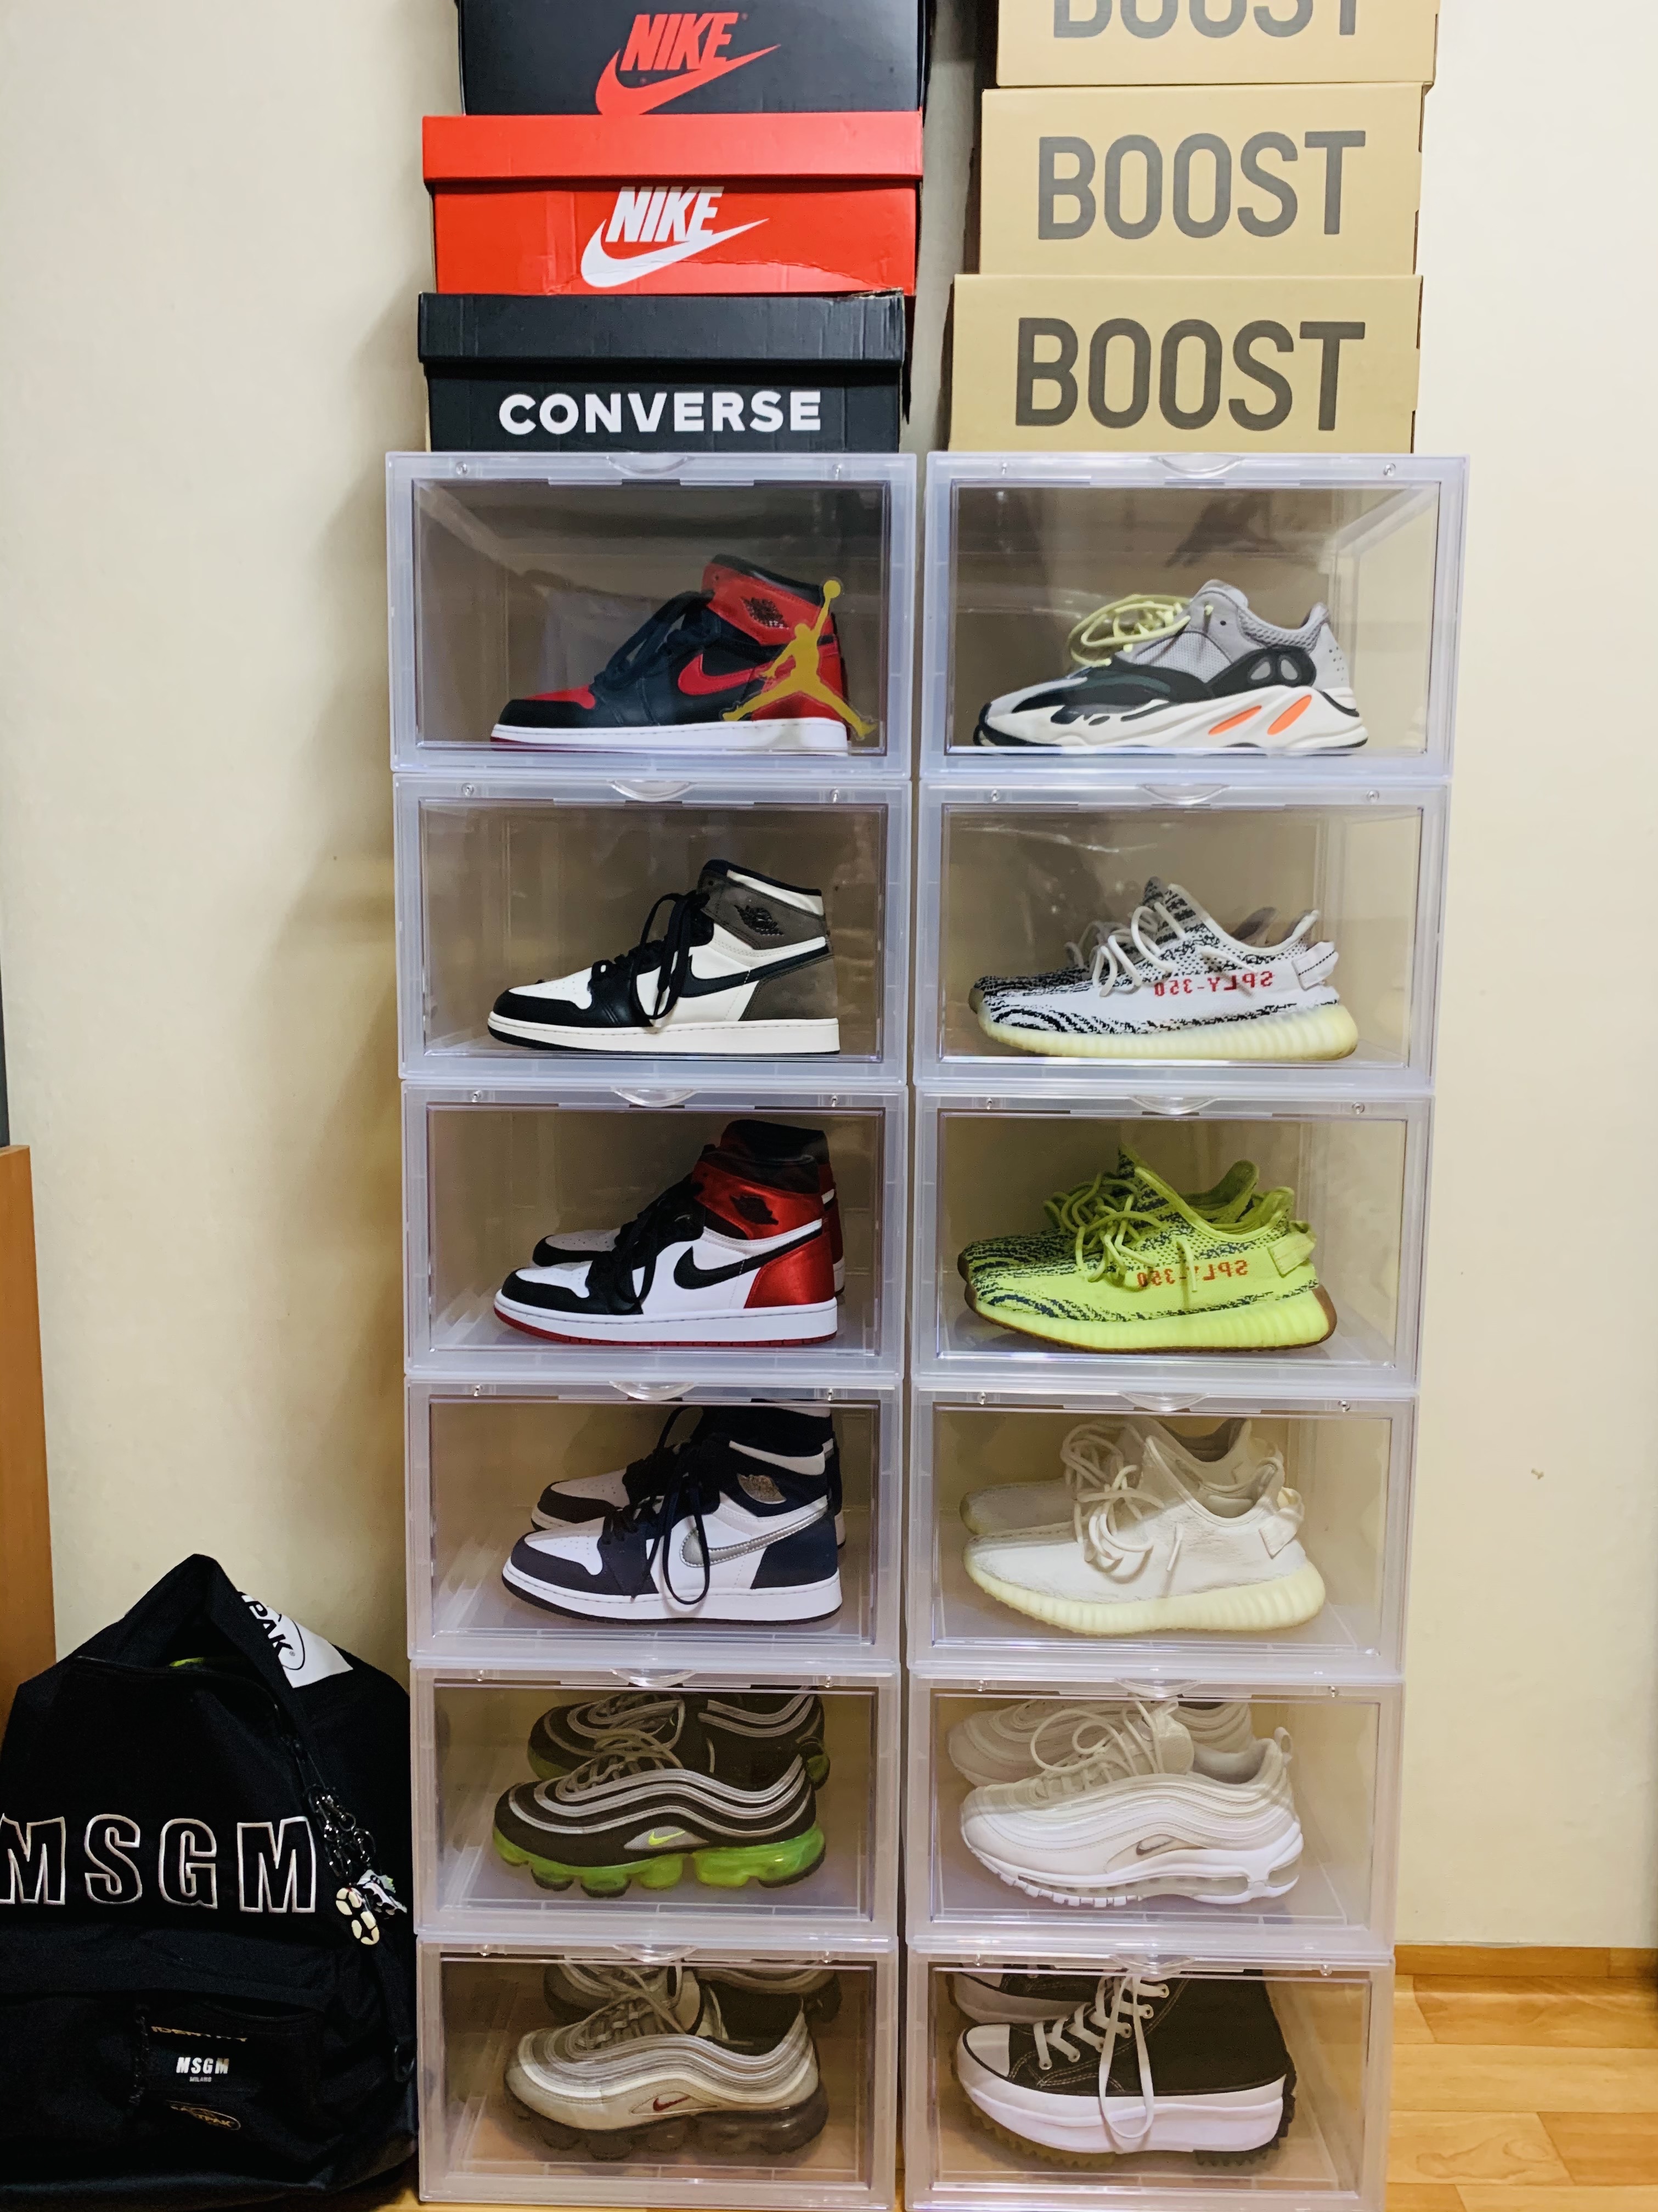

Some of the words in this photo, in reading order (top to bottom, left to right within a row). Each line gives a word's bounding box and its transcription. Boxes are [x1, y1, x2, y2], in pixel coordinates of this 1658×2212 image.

[620, 12, 739, 71] NIKE
[605, 186, 724, 242] NIKE
[1038, 131, 1366, 240] BOOST
[1015, 317, 1366, 431] BOOST
[499, 390, 821, 435] CONVERSE
[0, 1814, 317, 1914] MSGM
[176, 2057, 230, 2074] MSGM
